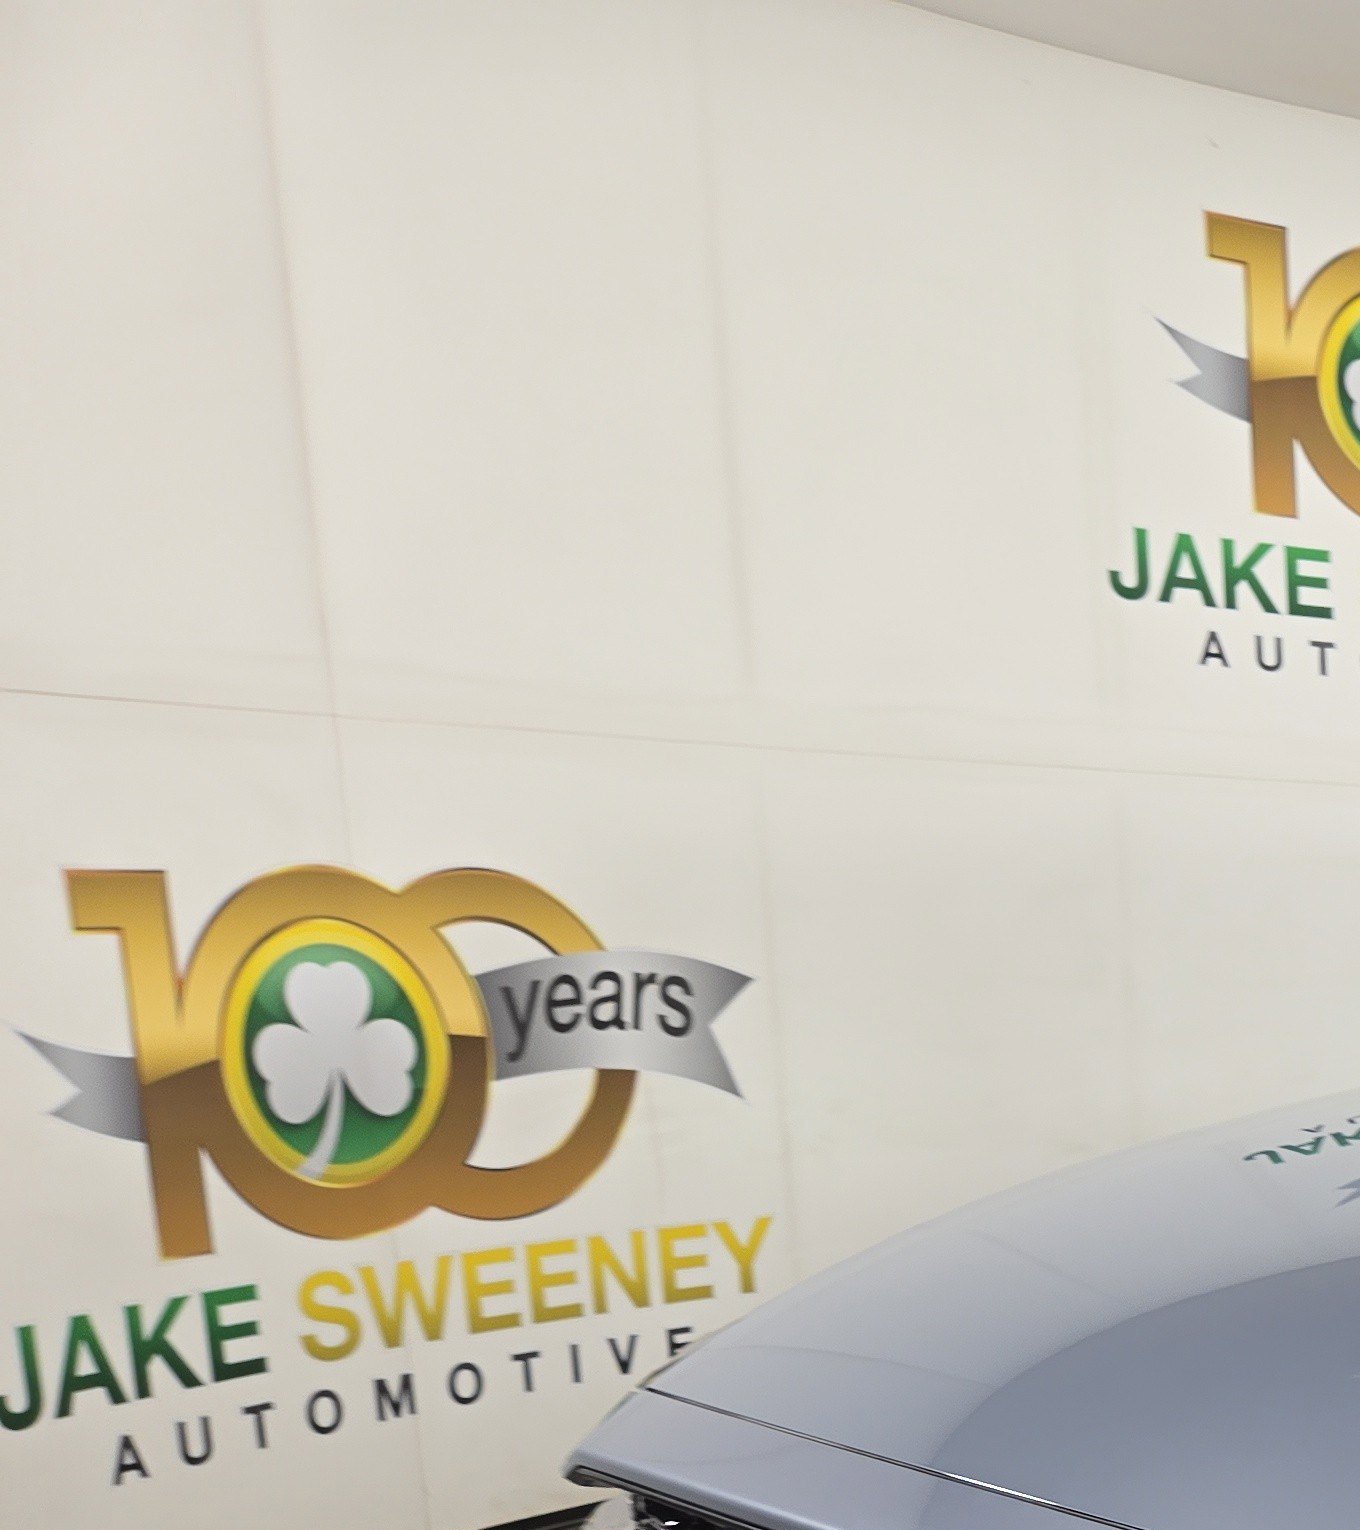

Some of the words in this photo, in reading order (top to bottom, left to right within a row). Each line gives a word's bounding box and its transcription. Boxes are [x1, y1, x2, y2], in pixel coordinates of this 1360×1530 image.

[1109, 527, 1333, 620] JAKE
[63, 863, 639, 1260] 100
[500, 970, 695, 1061] years
[0, 1283, 268, 1431] JAKE
[297, 1215, 775, 1364] SWEENEY
